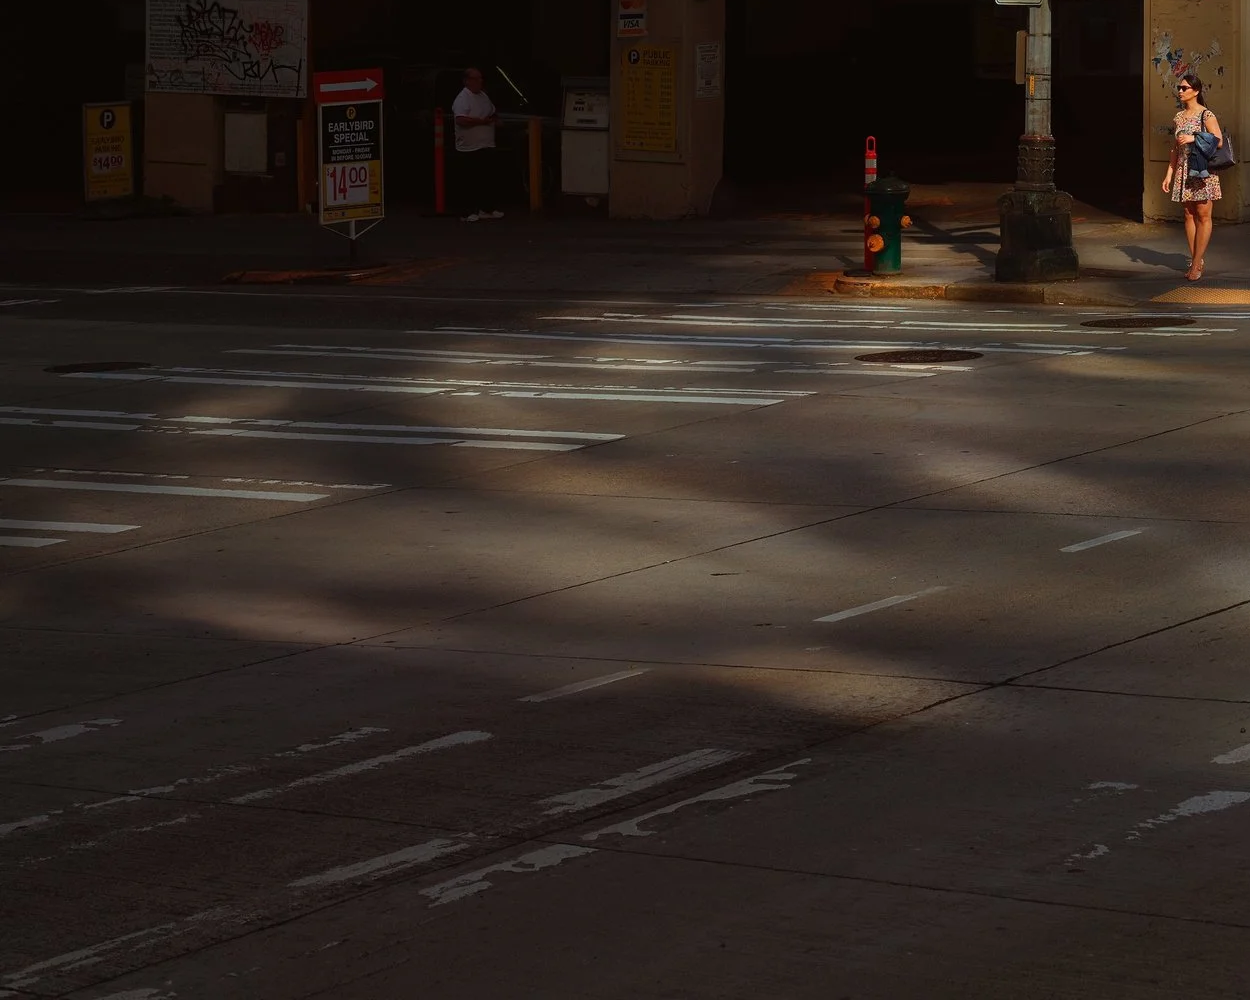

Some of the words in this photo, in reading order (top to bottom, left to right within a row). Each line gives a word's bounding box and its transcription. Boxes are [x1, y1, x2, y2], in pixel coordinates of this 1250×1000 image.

[623, 19, 641, 29] VISA
[643, 50, 671, 59] PUBLIC
[328, 120, 375, 133] EARLYBIRD
[333, 133, 370, 144] SPECIAL
